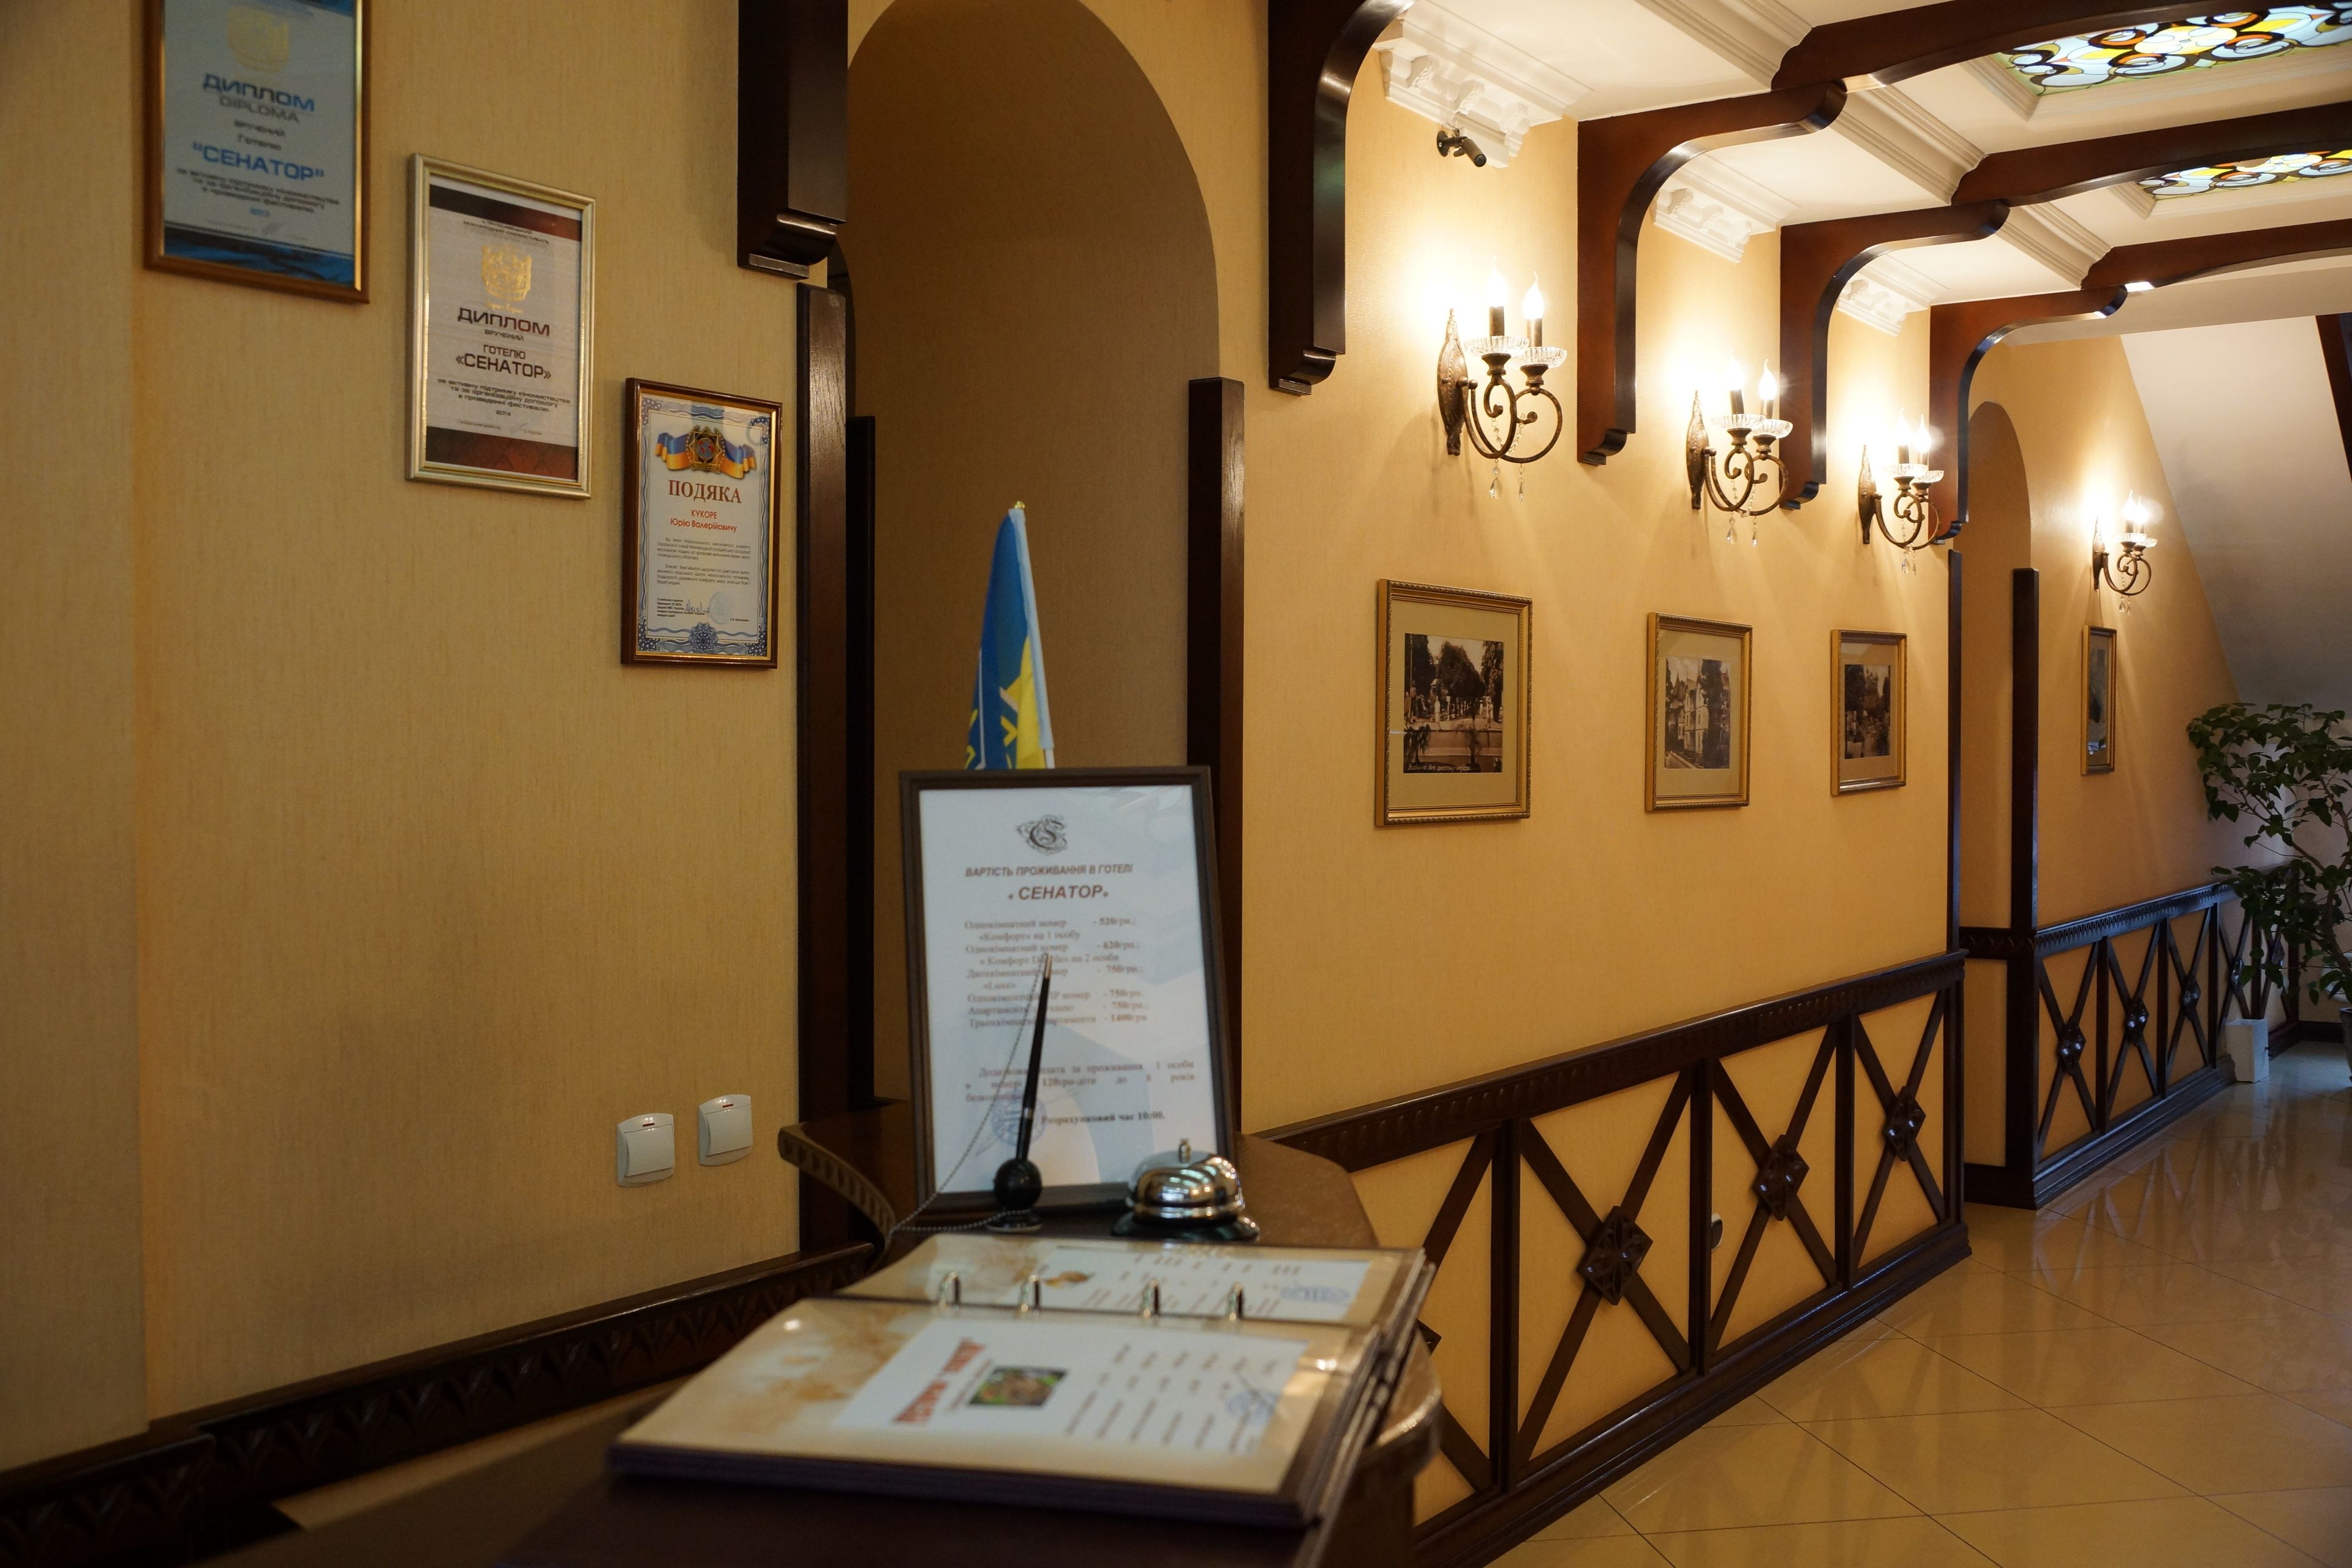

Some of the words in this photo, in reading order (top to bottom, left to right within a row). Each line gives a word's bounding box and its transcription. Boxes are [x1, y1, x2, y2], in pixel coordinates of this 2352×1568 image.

[203, 73, 315, 112] ДИПЛОМ
[219, 95, 300, 123] DIPLOMA
[458, 307, 550, 336] ДИПЛОМ
[483, 344, 526, 360] ГОТЕЛЮ
[456, 353, 552, 379] «СЕНАТОР»
[668, 480, 742, 503] ПОДЯКА
[671, 518, 690, 527] Юрію
[692, 521, 737, 533] Валерійовичу
[691, 510, 718, 519] КУКОРЕ
[965, 867, 1014, 877] ВАРТІСТЬ
[1016, 865, 1087, 876] ПРОЖИВАННЯ
